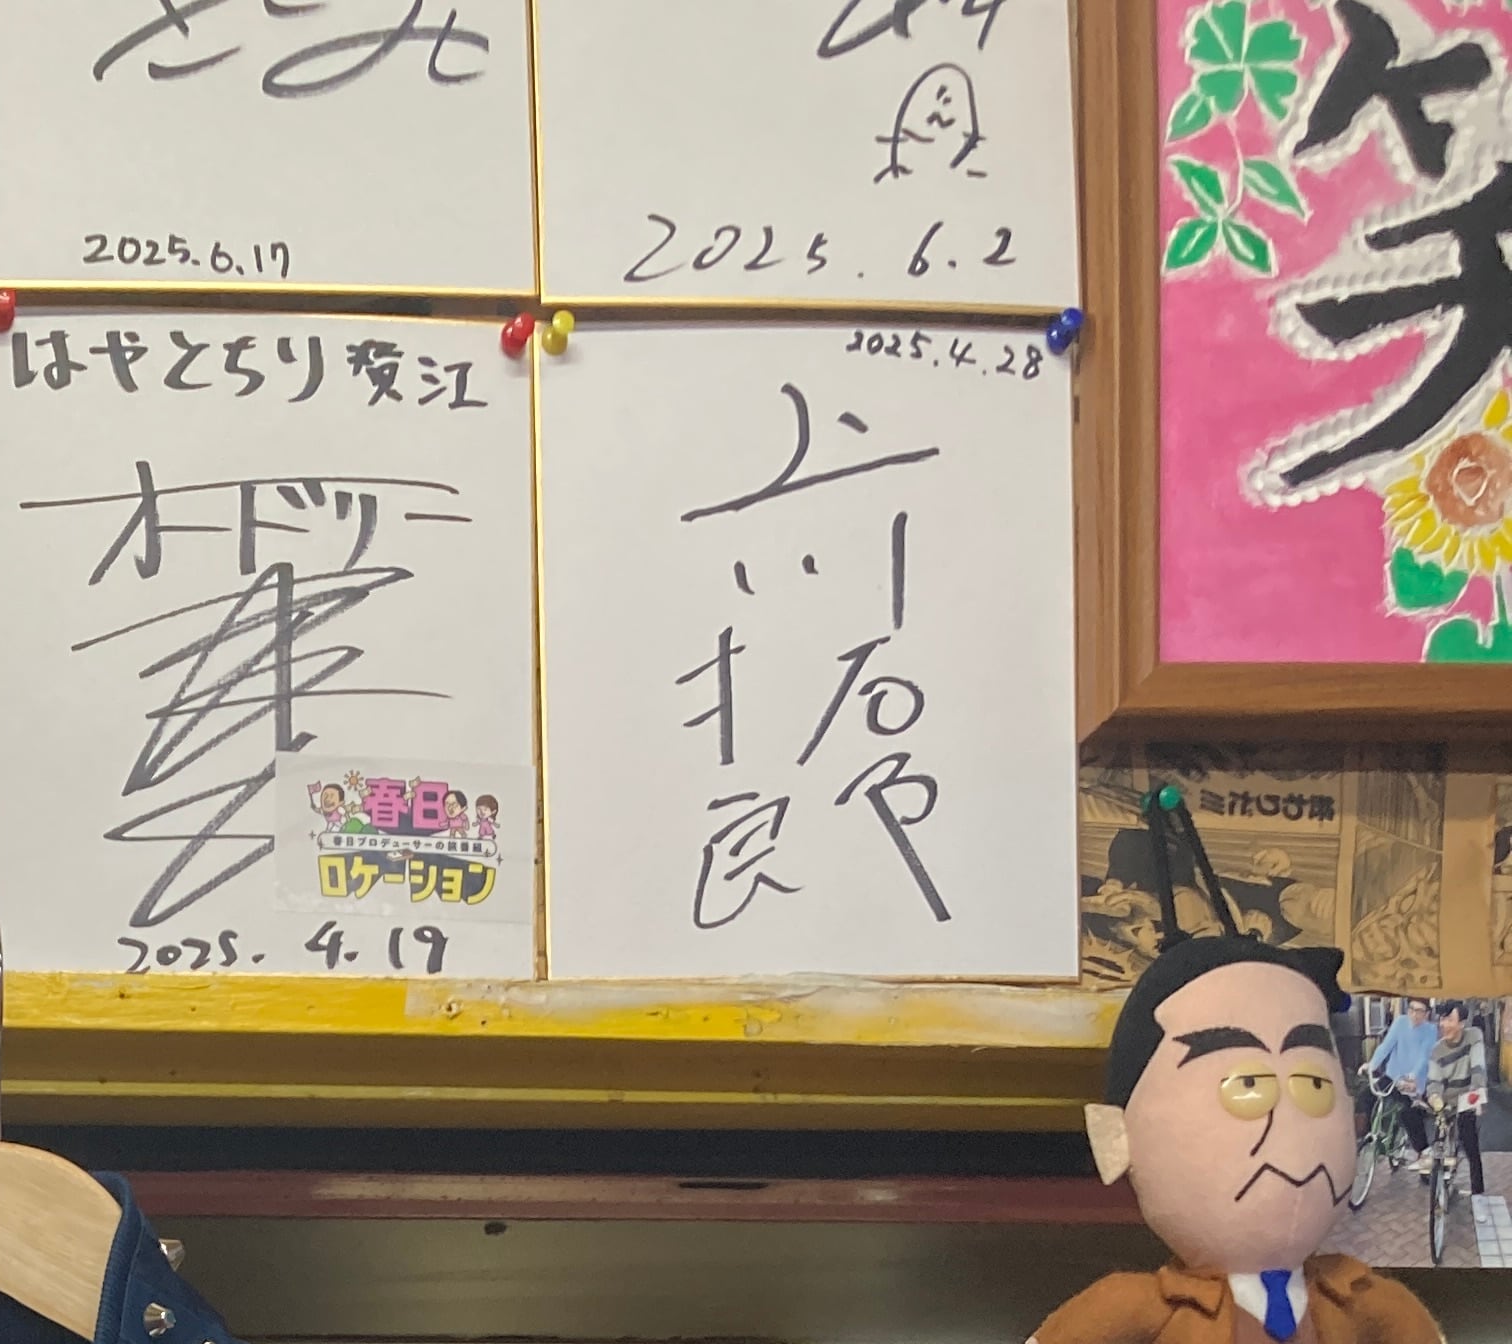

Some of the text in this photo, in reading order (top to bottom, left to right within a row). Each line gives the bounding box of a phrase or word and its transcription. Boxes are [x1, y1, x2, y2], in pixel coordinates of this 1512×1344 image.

[83, 233, 290, 278] 2025.6.17
[845, 330, 1044, 380] 2025.4.28
[362, 777, 449, 832] 春日
[317, 853, 497, 905] ロケーション
